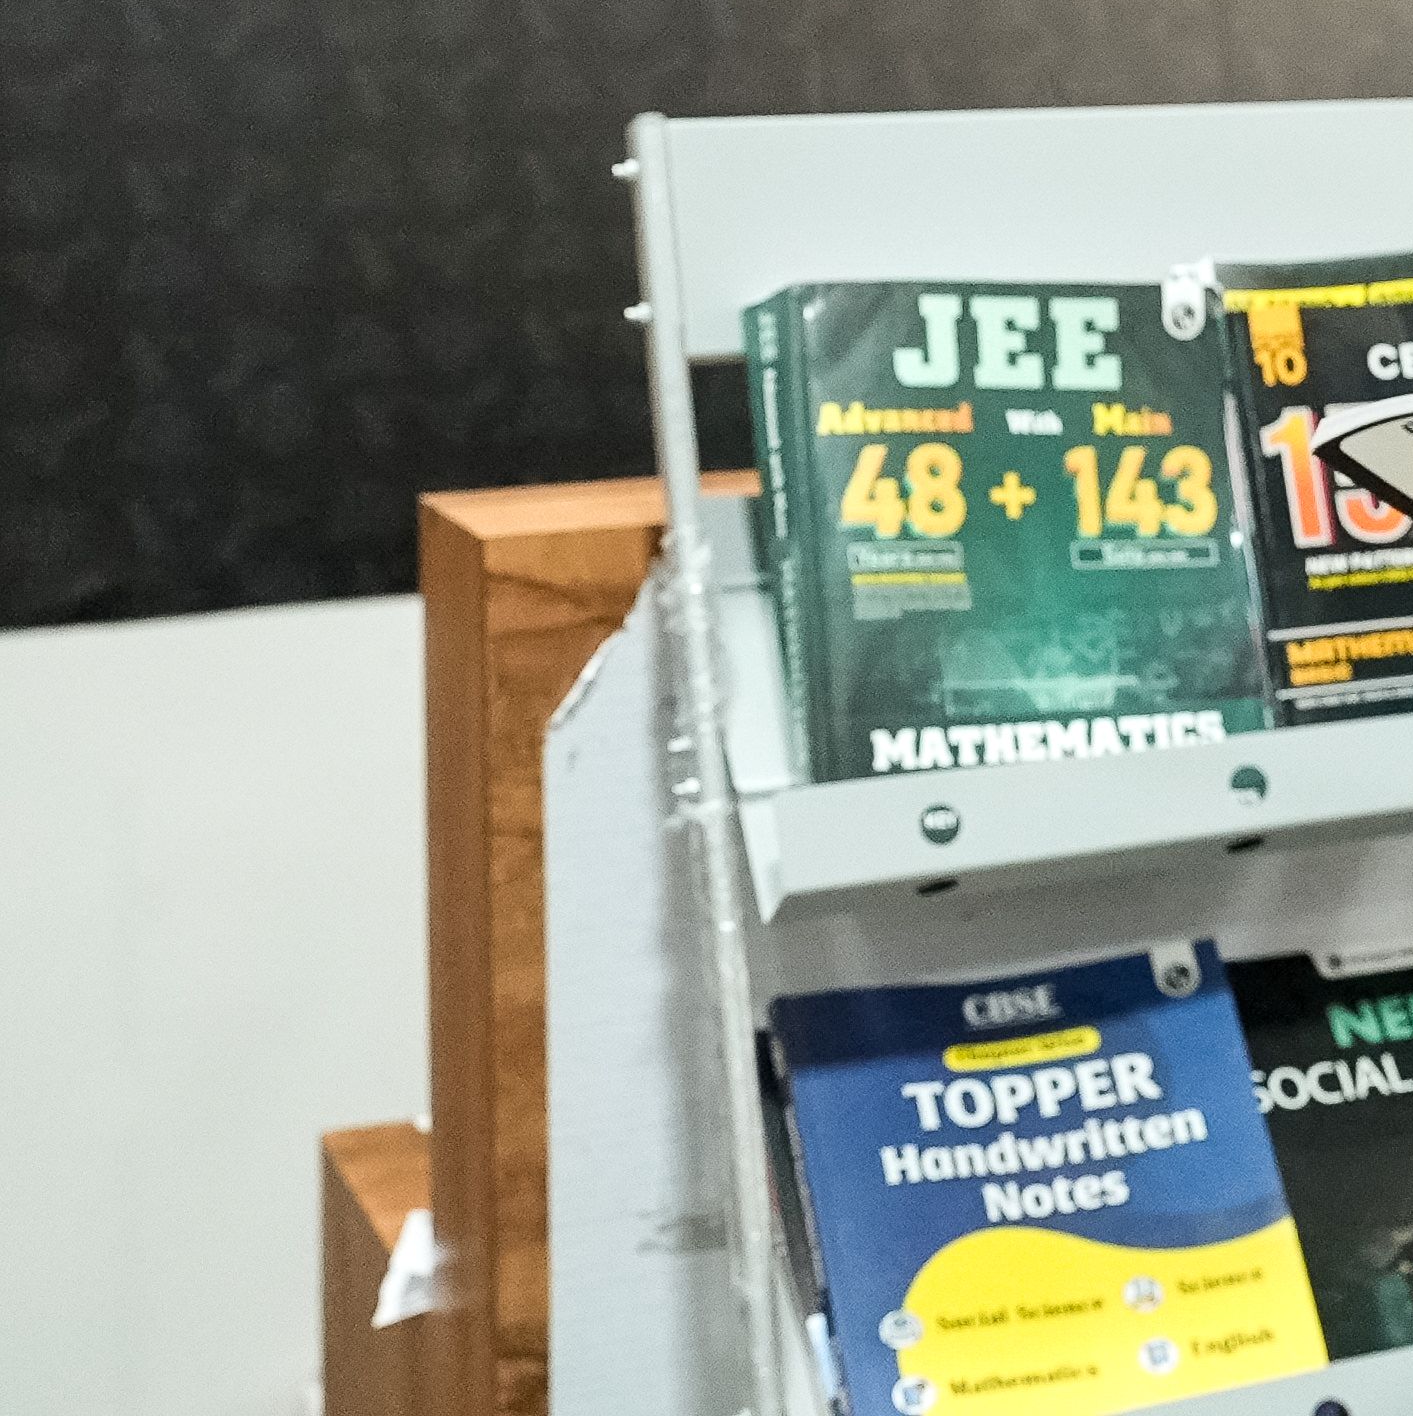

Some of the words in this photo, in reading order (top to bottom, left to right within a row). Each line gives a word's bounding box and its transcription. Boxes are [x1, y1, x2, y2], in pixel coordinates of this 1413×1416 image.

[893, 293, 1122, 391] JEE
[1254, 348, 1307, 386] 10
[1093, 403, 1172, 436] Main
[840, 442, 968, 539] 48
[1063, 444, 1218, 538] 143
[870, 710, 1226, 773] MATHEMATICS
[903, 1051, 1163, 1131] TOPPER
[880, 1107, 1208, 1185] Handwritten
[982, 1171, 1130, 1224] Notes
